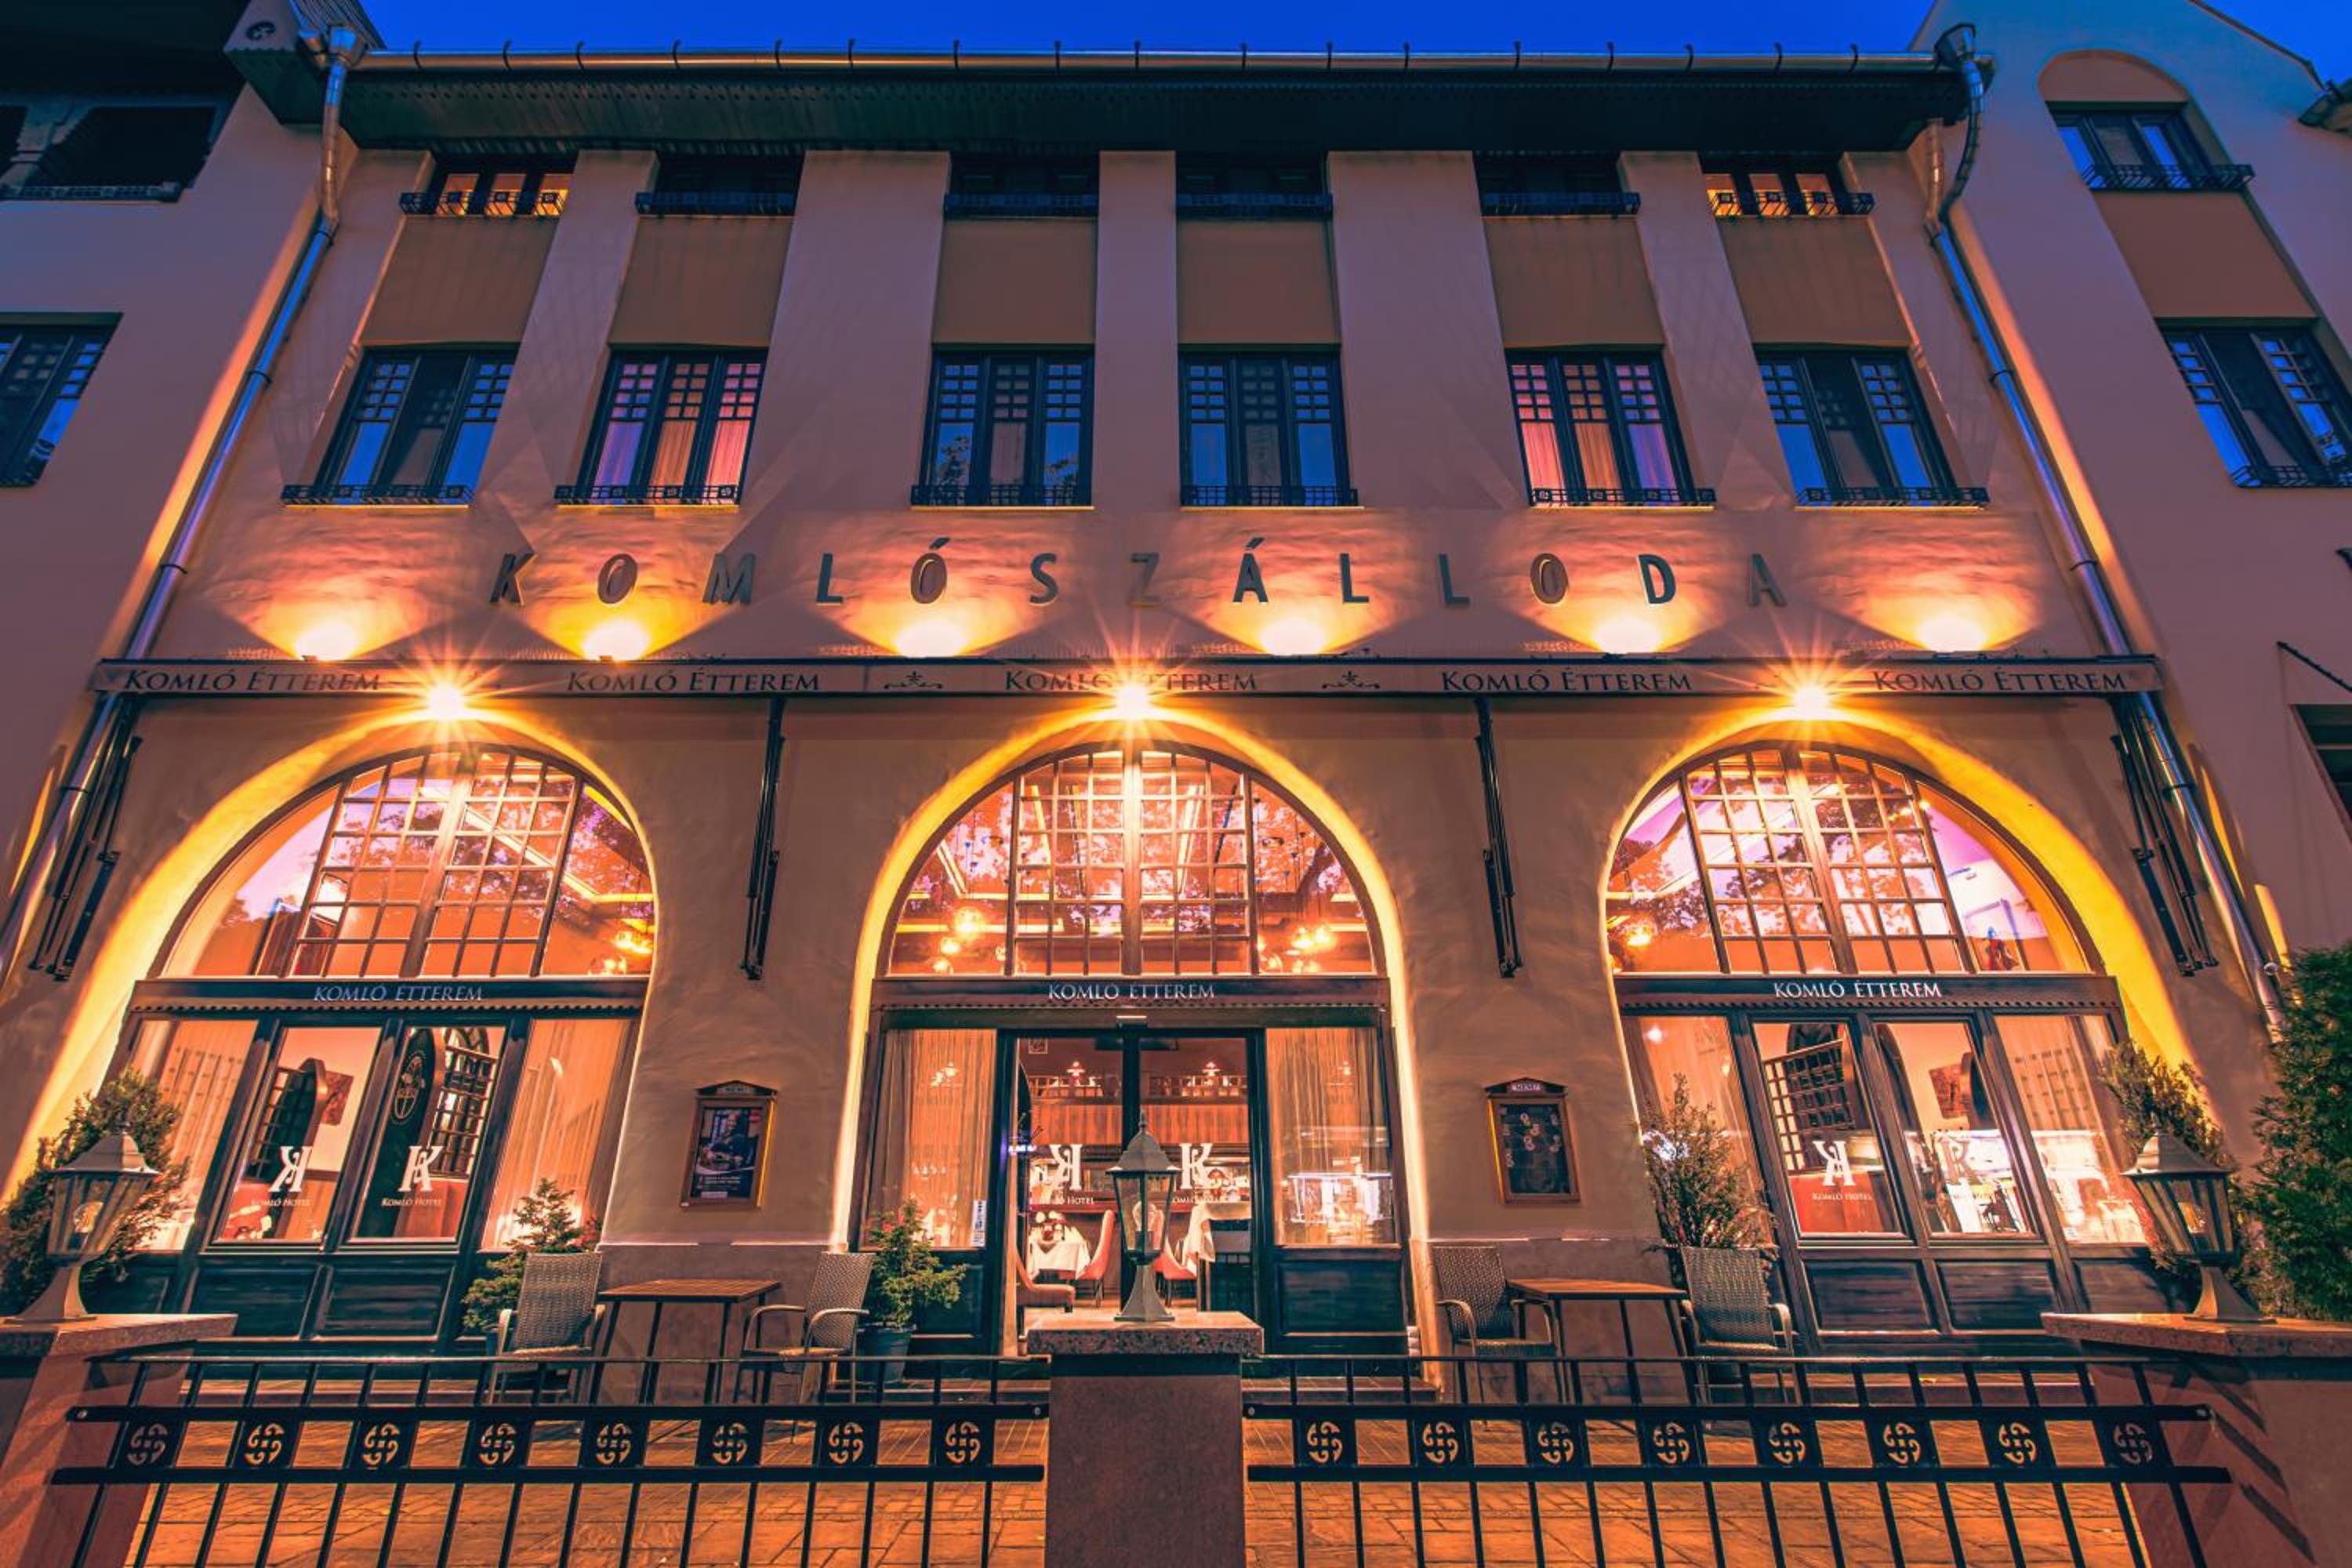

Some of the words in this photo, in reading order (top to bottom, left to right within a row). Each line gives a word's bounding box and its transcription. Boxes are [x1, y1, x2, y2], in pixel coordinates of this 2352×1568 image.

[124, 667, 236, 691] KOMLÓ
[246, 666, 379, 691] ÉTTEREM
[567, 670, 677, 691] KOMLÓ
[689, 667, 821, 691] ÉTTEREM
[1129, 669, 1257, 691] TTEREM
[1441, 670, 1550, 691] KOMLÓ
[1561, 667, 1693, 691] ÉTTEREM
[1872, 669, 1984, 691] KOMLÓ
[1994, 666, 2127, 691] ÉTTEREM
[1773, 980, 1846, 998] KOMLÓ
